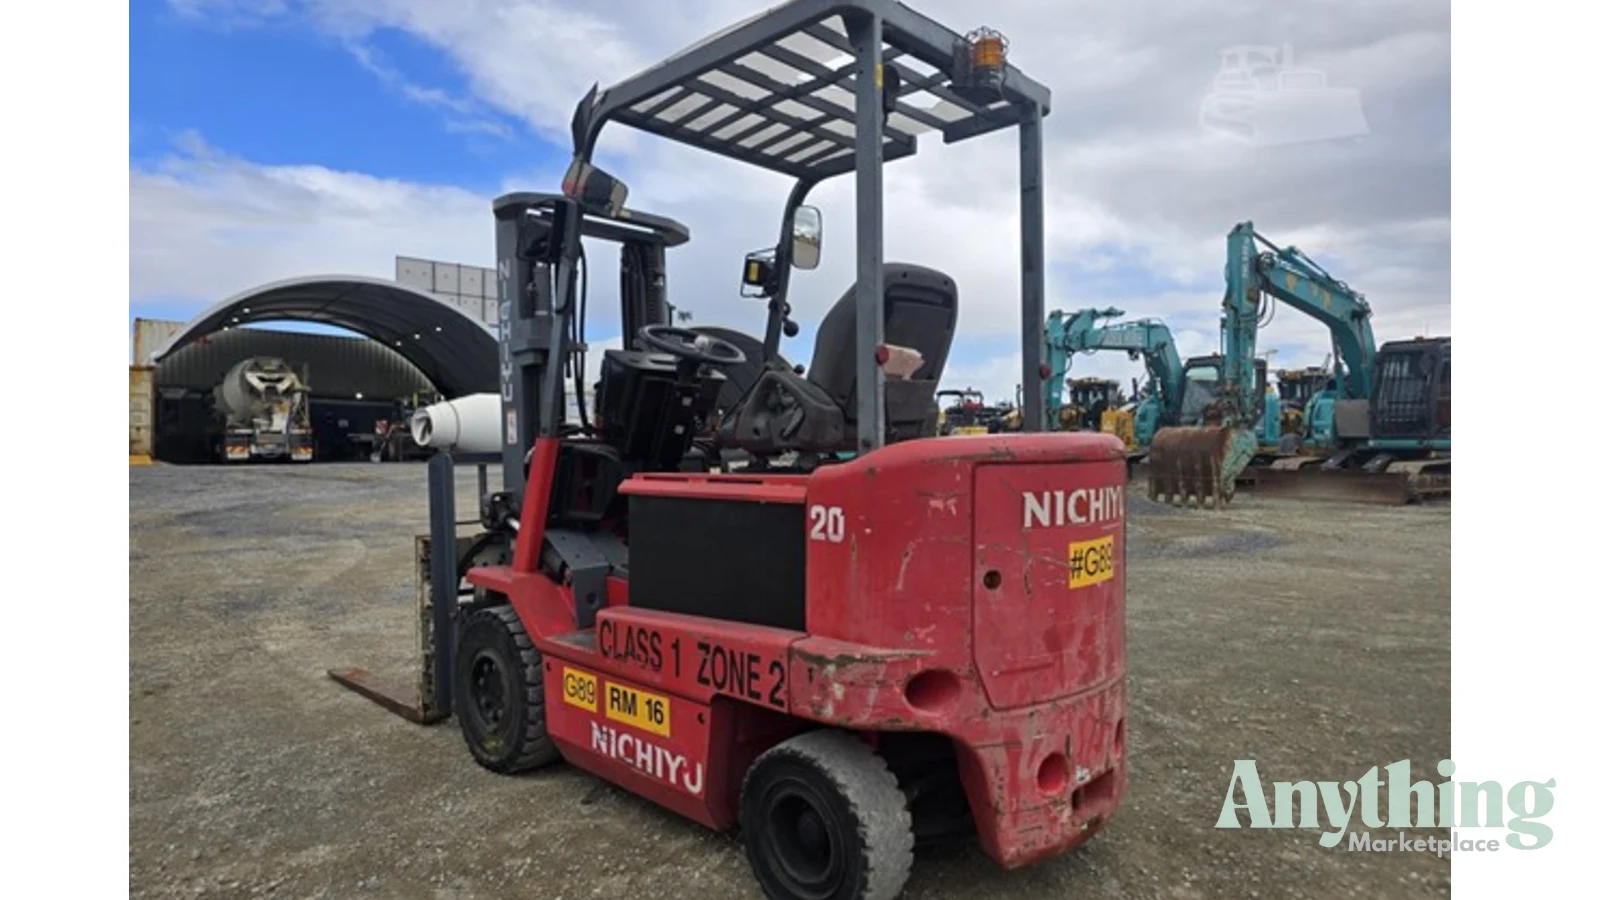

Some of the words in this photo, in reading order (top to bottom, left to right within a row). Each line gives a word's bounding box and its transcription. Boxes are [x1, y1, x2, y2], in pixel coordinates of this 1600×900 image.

[499, 258, 514, 402] NICHIYU
[810, 505, 845, 543] 20
[564, 672, 596, 706] G89
[598, 619, 663, 672] CLASS
[671, 637, 681, 678] 1
[697, 641, 762, 700] ZONE
[768, 659, 785, 707] 2
[609, 685, 638, 718] RM
[645, 697, 665, 725] 16
[590, 721, 703, 795] NICHIYU
